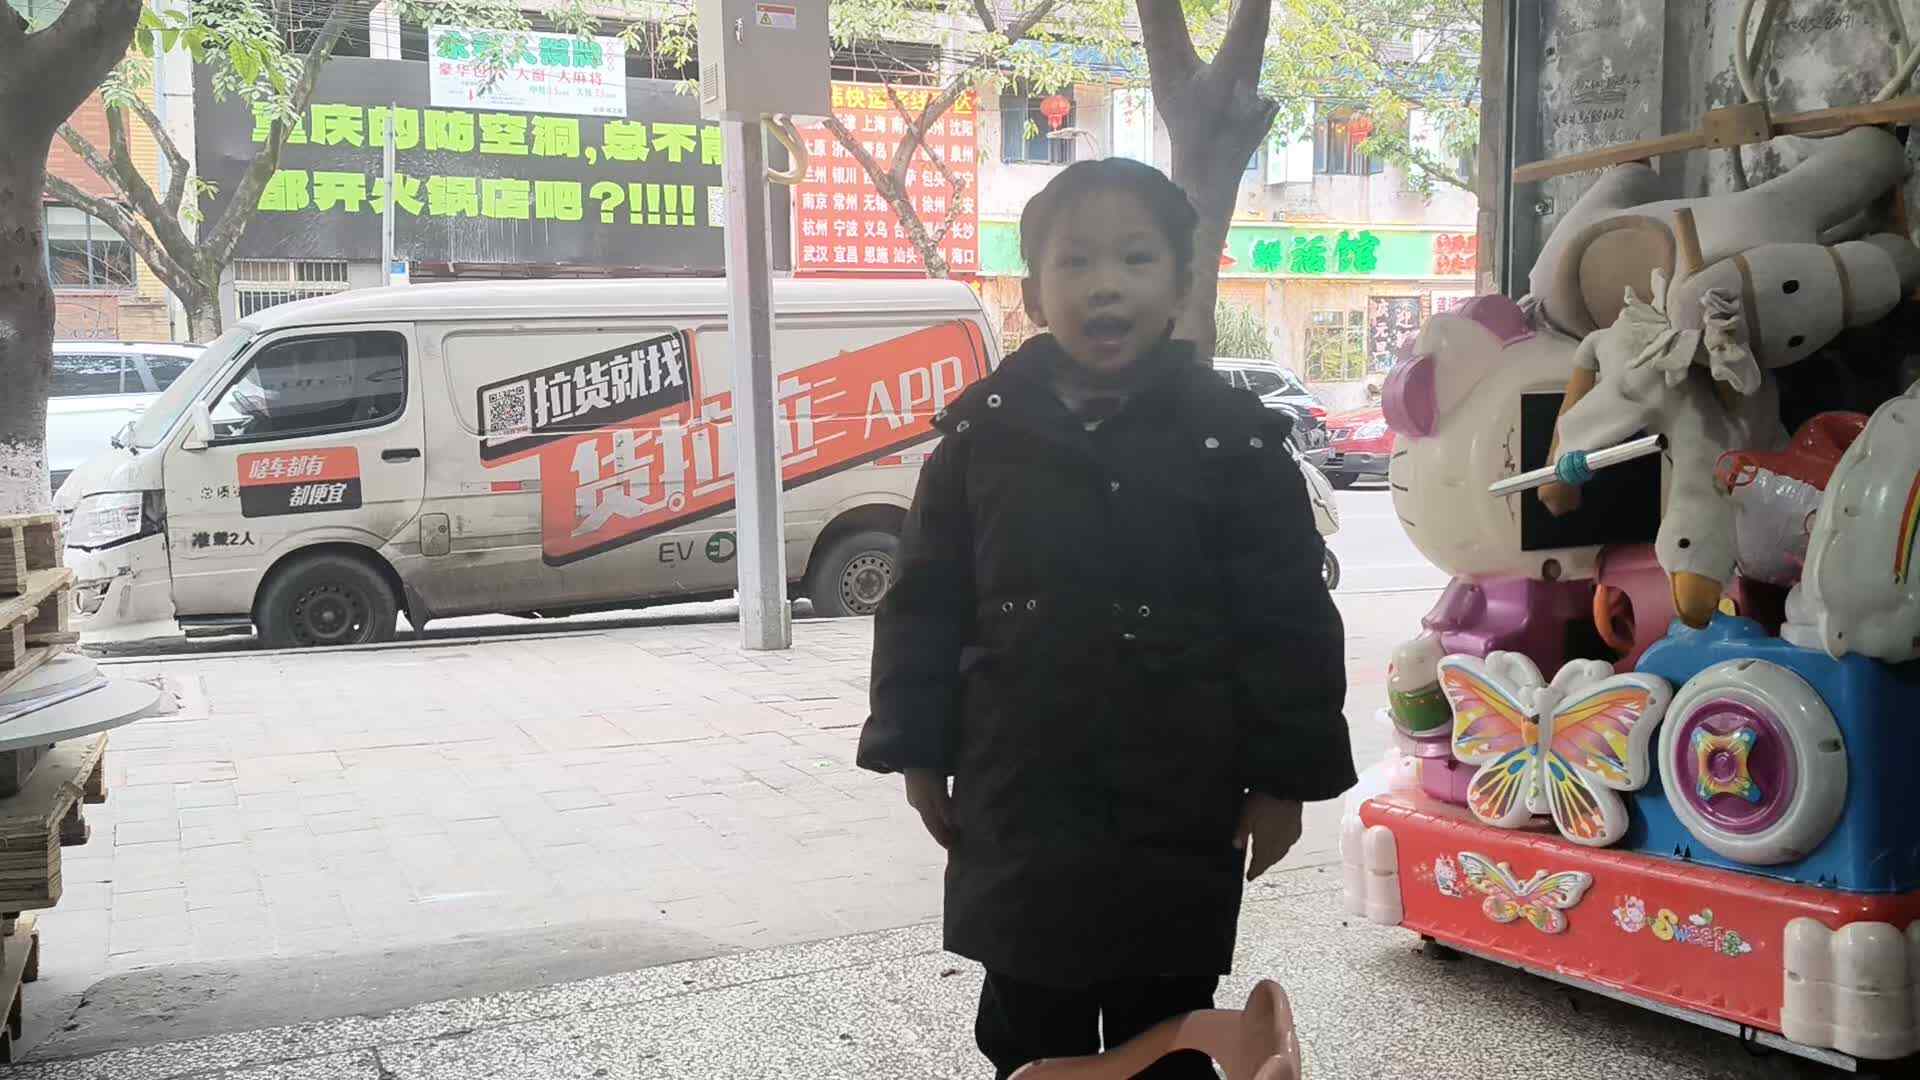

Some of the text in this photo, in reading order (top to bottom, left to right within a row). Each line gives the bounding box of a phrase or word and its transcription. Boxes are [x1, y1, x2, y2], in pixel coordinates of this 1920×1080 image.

[863, 114, 886, 134] 上海
[802, 165, 827, 185] 兰州
[922, 170, 946, 188] 包头
[802, 192, 828, 210] 南京
[832, 192, 858, 211] 常州
[802, 218, 828, 237] 杭州
[833, 219, 859, 237] 宁波
[864, 221, 888, 239] 义乌
[951, 222, 975, 240] 长沙
[803, 245, 828, 263] 武汉
[833, 245, 858, 264] 宜昌
[951, 249, 975, 265] 海口
[533, 340, 685, 429] 拉货就找
[864, 356, 965, 440] APP
[288, 483, 347, 508] 都便宜
[659, 539, 695, 564] EV
